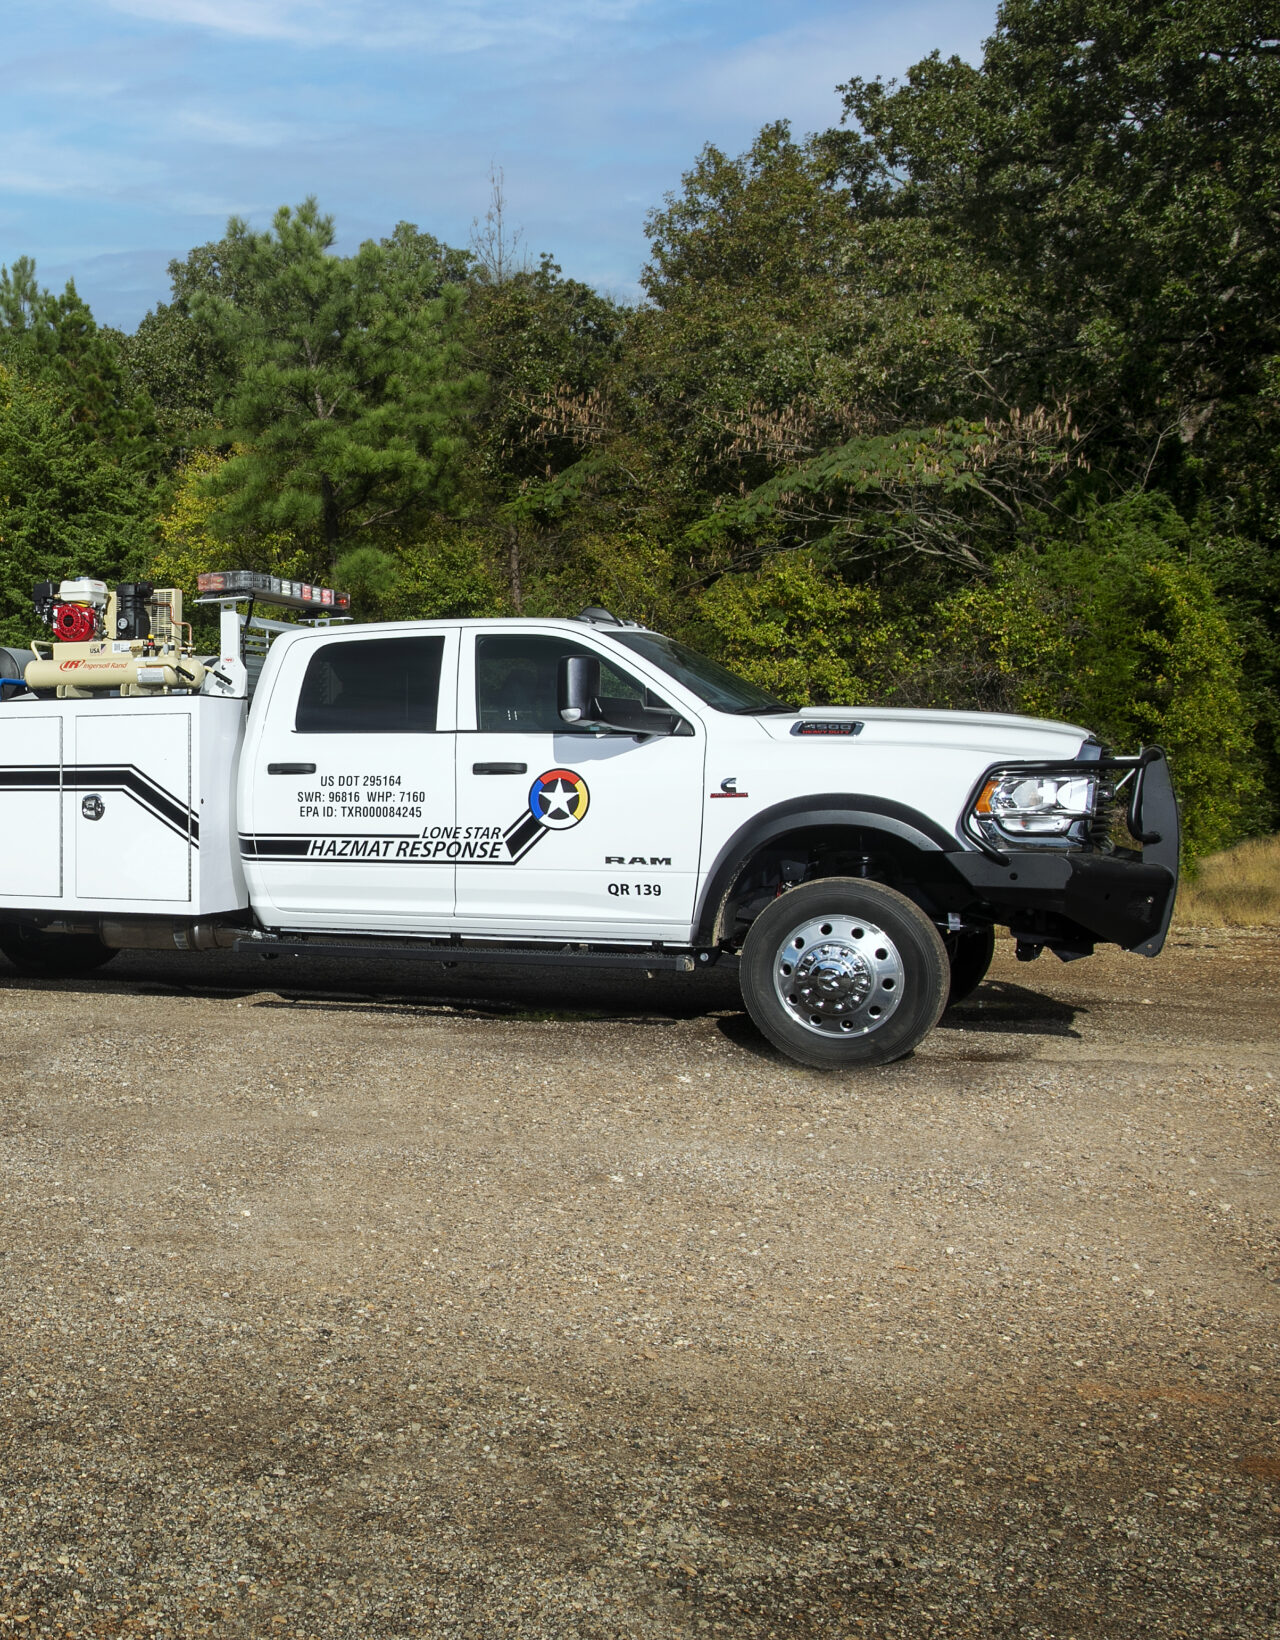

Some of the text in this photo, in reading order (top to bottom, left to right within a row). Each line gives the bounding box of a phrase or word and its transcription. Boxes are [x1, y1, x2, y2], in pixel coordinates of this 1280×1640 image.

[320, 775, 402, 787] US DOT 295164
[297, 791, 426, 803] SWR: 96816 WHP: 7160
[300, 806, 422, 818] EPA ID: TXR000084245
[422, 827, 501, 839] LONE STAR
[310, 840, 503, 858] HAZMAT RESPONSE
[605, 856, 672, 866] RAM
[607, 883, 662, 897] QR 139
